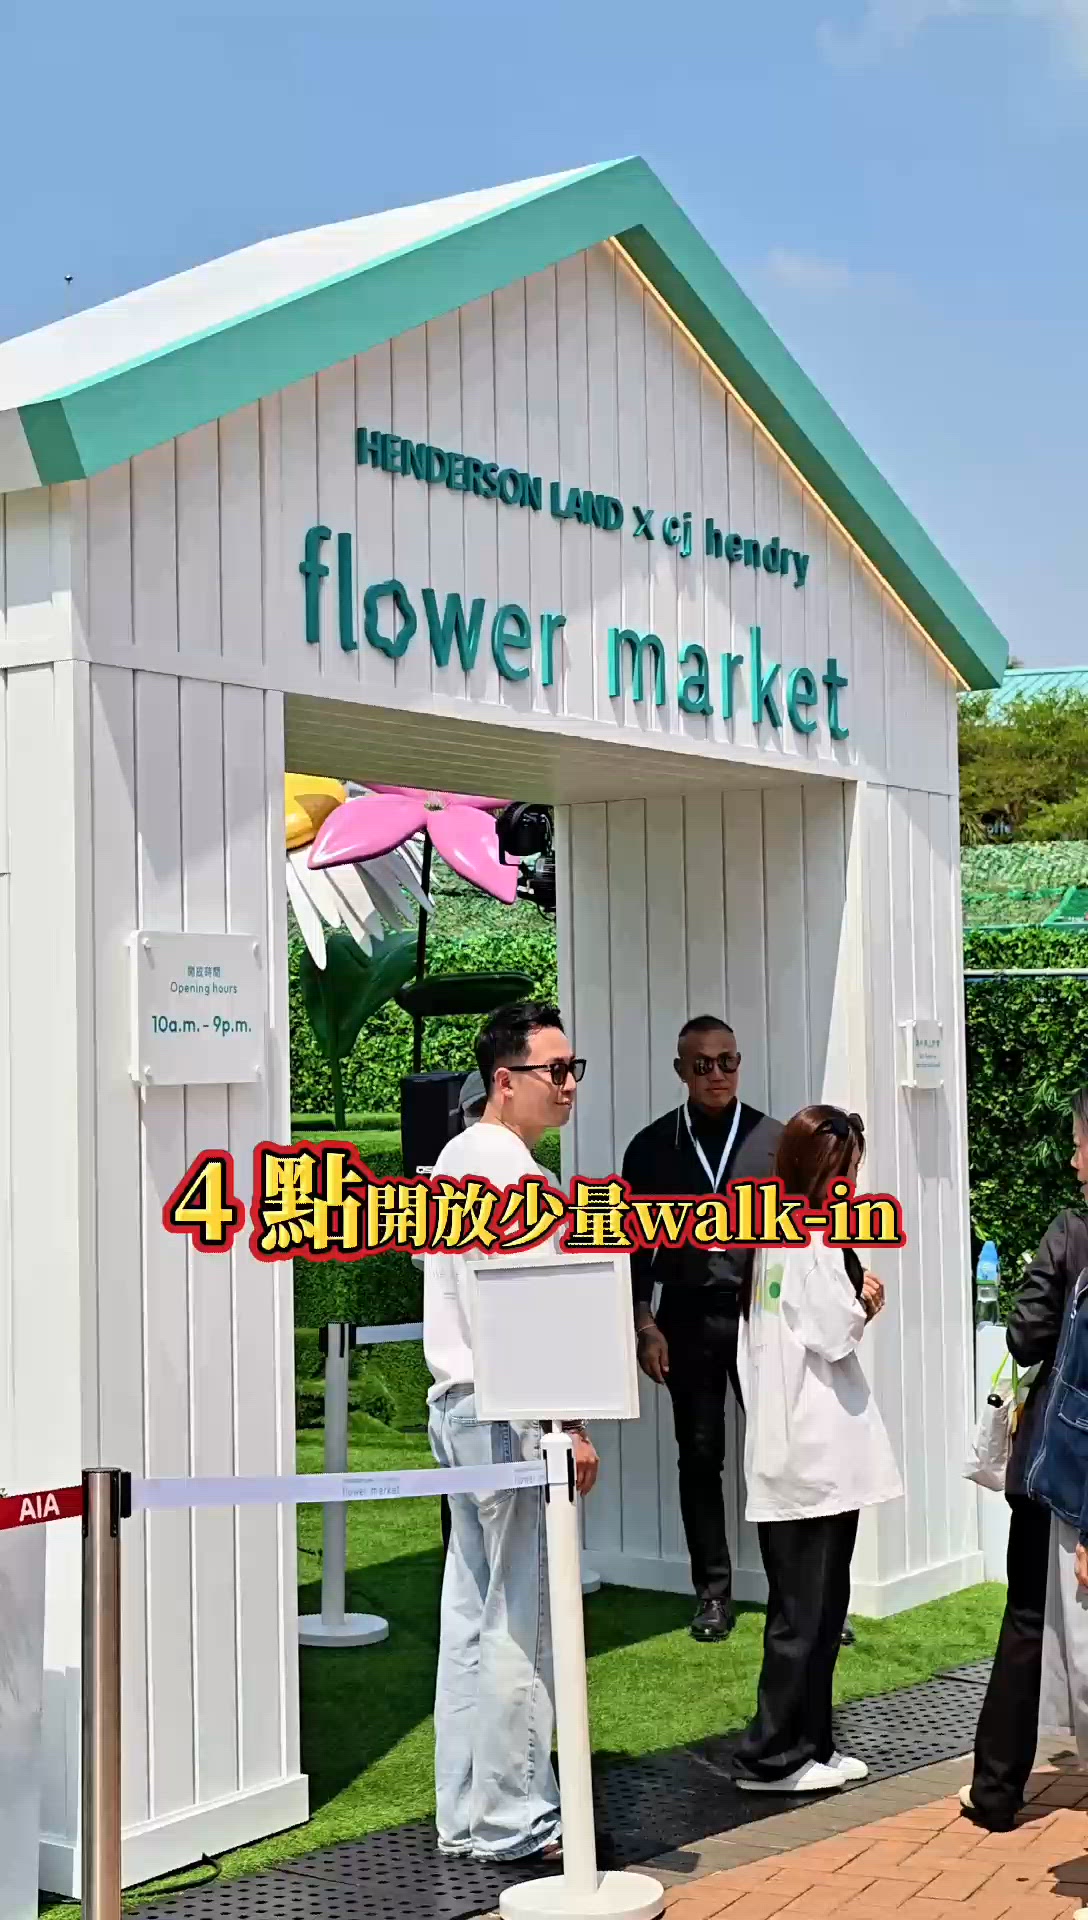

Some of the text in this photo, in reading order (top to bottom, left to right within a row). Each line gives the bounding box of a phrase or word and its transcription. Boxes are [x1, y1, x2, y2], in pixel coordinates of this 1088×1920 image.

[356, 427, 543, 511] HENDERSON
[549, 481, 625, 532] LAND
[662, 511, 693, 558] cj
[704, 517, 810, 589] hendry
[299, 524, 850, 742] flower market
[170, 981, 238, 996] Opening hours
[152, 1015, 200, 1033] 10a.m.
[213, 1015, 252, 1037] 9p.m.
[19, 1492, 60, 1522] AIA
